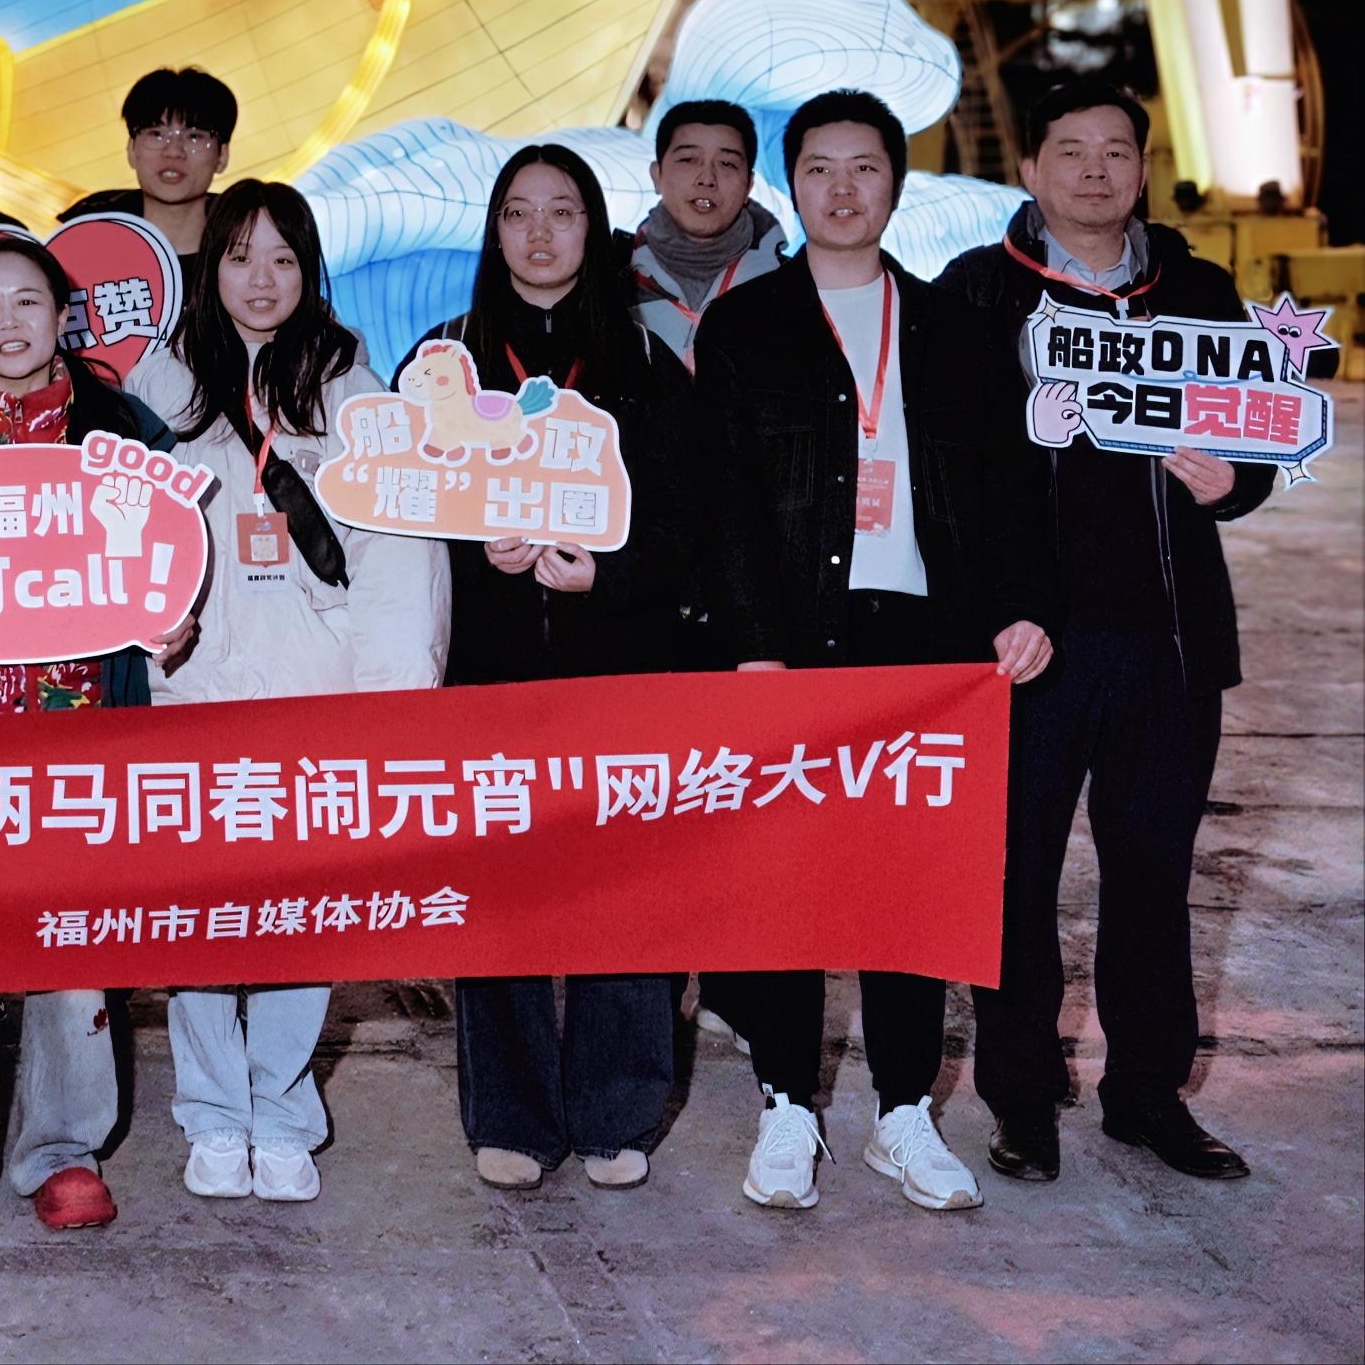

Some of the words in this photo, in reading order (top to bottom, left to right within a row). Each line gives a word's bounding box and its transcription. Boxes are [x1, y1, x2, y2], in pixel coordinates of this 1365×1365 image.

[1047, 325, 1275, 382] 船政DNA
[1087, 381, 1303, 446] 今日觉醒
[87, 435, 211, 502] good
[35, 885, 469, 949] 福州市自媒体协会
